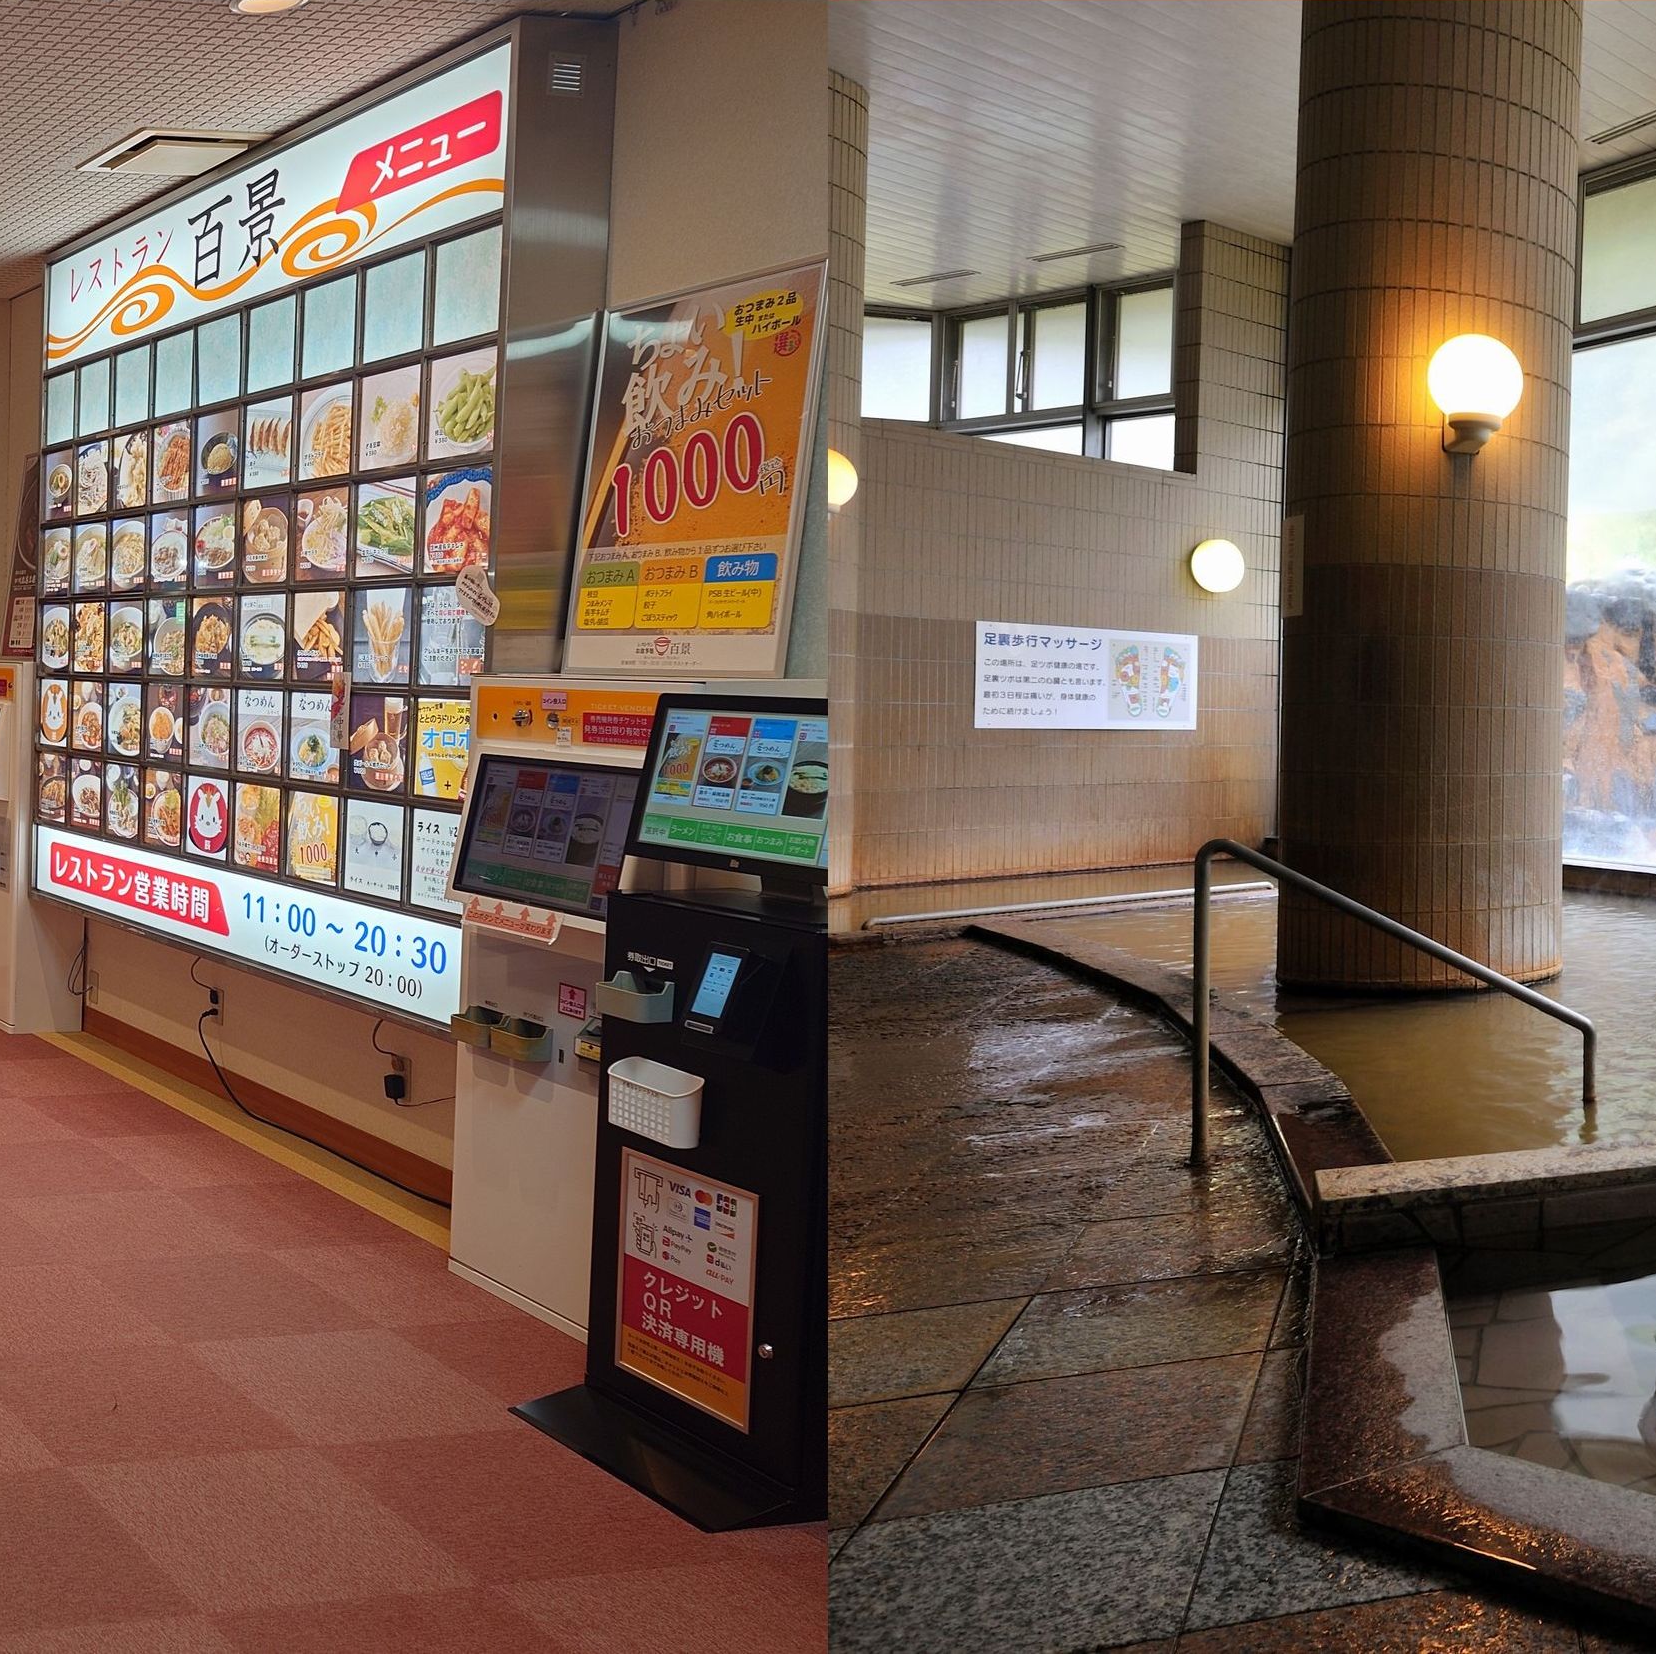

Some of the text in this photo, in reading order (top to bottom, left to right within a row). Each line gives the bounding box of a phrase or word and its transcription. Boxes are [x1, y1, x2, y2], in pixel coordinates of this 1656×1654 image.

[370, 120, 486, 193] メニュー
[69, 168, 286, 303] レストラン 百景
[734, 291, 797, 316] おつまみ2品
[735, 313, 754, 327] 生中
[751, 315, 801, 334] ハイボール
[629, 369, 773, 449] おつまみセット
[611, 411, 786, 538] 1000 円
[586, 568, 635, 585] おつまみ A
[644, 564, 698, 581] おつまみ B
[717, 560, 760, 577] 飲み物
[645, 589, 673, 597] ポテトフライ
[706, 610, 742, 619] 角ハイボール
[670, 643, 692, 655] 百景
[983, 632, 1103, 651] 足裏歩行マッサージ
[244, 695, 276, 708] なつめん
[299, 698, 332, 712] なつめん
[982, 706, 1059, 716] ために続けましょう！
[417, 821, 440, 834] ライス
[671, 824, 695, 836] ラーメン
[726, 832, 753, 844] お食事
[756, 836, 784, 847] おつまみ
[299, 843, 327, 864] 1000
[55, 850, 209, 923] レストラン営業時間
[365, 964, 423, 999] 20:00)
[668, 1180, 692, 1198] VISA
[716, 1193, 737, 1217] JCB
[670, 1241, 692, 1255] PayPay
[643, 1271, 724, 1319] クレジット
[643, 1293, 672, 1320] QR
[642, 1313, 725, 1368] 決済専用機
